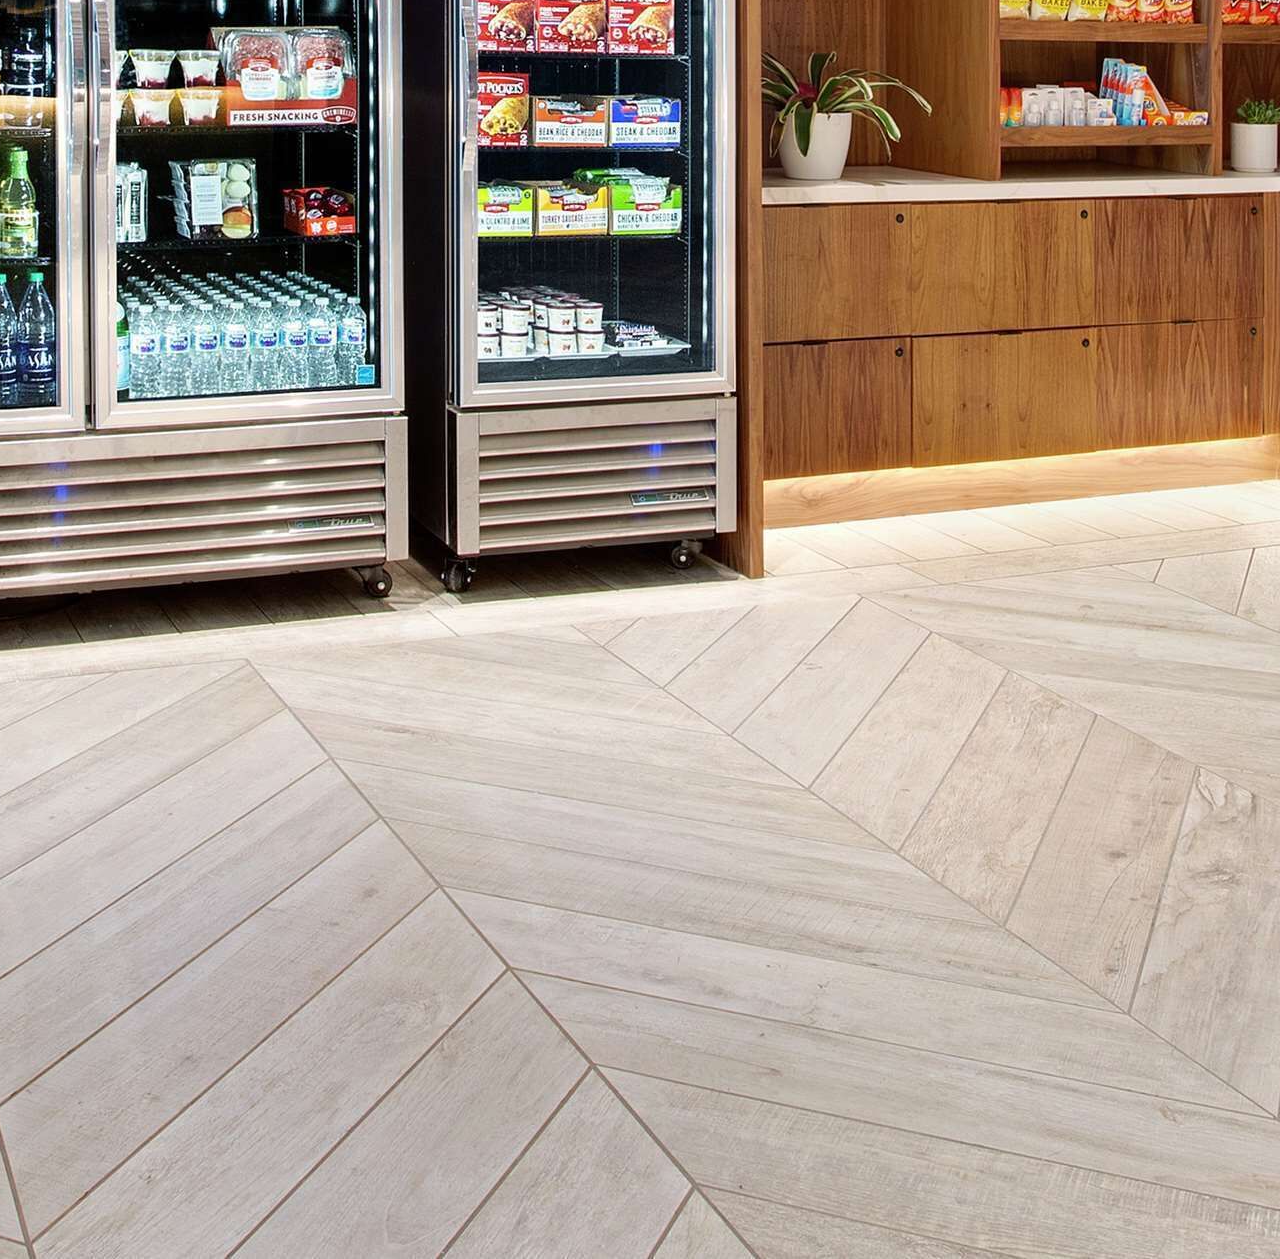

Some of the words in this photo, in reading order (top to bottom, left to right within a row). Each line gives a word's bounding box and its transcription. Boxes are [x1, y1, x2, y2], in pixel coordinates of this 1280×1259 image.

[233, 113, 266, 122] FRESH
[268, 112, 319, 121] SNACKING
[617, 215, 643, 224] CHICKEN
